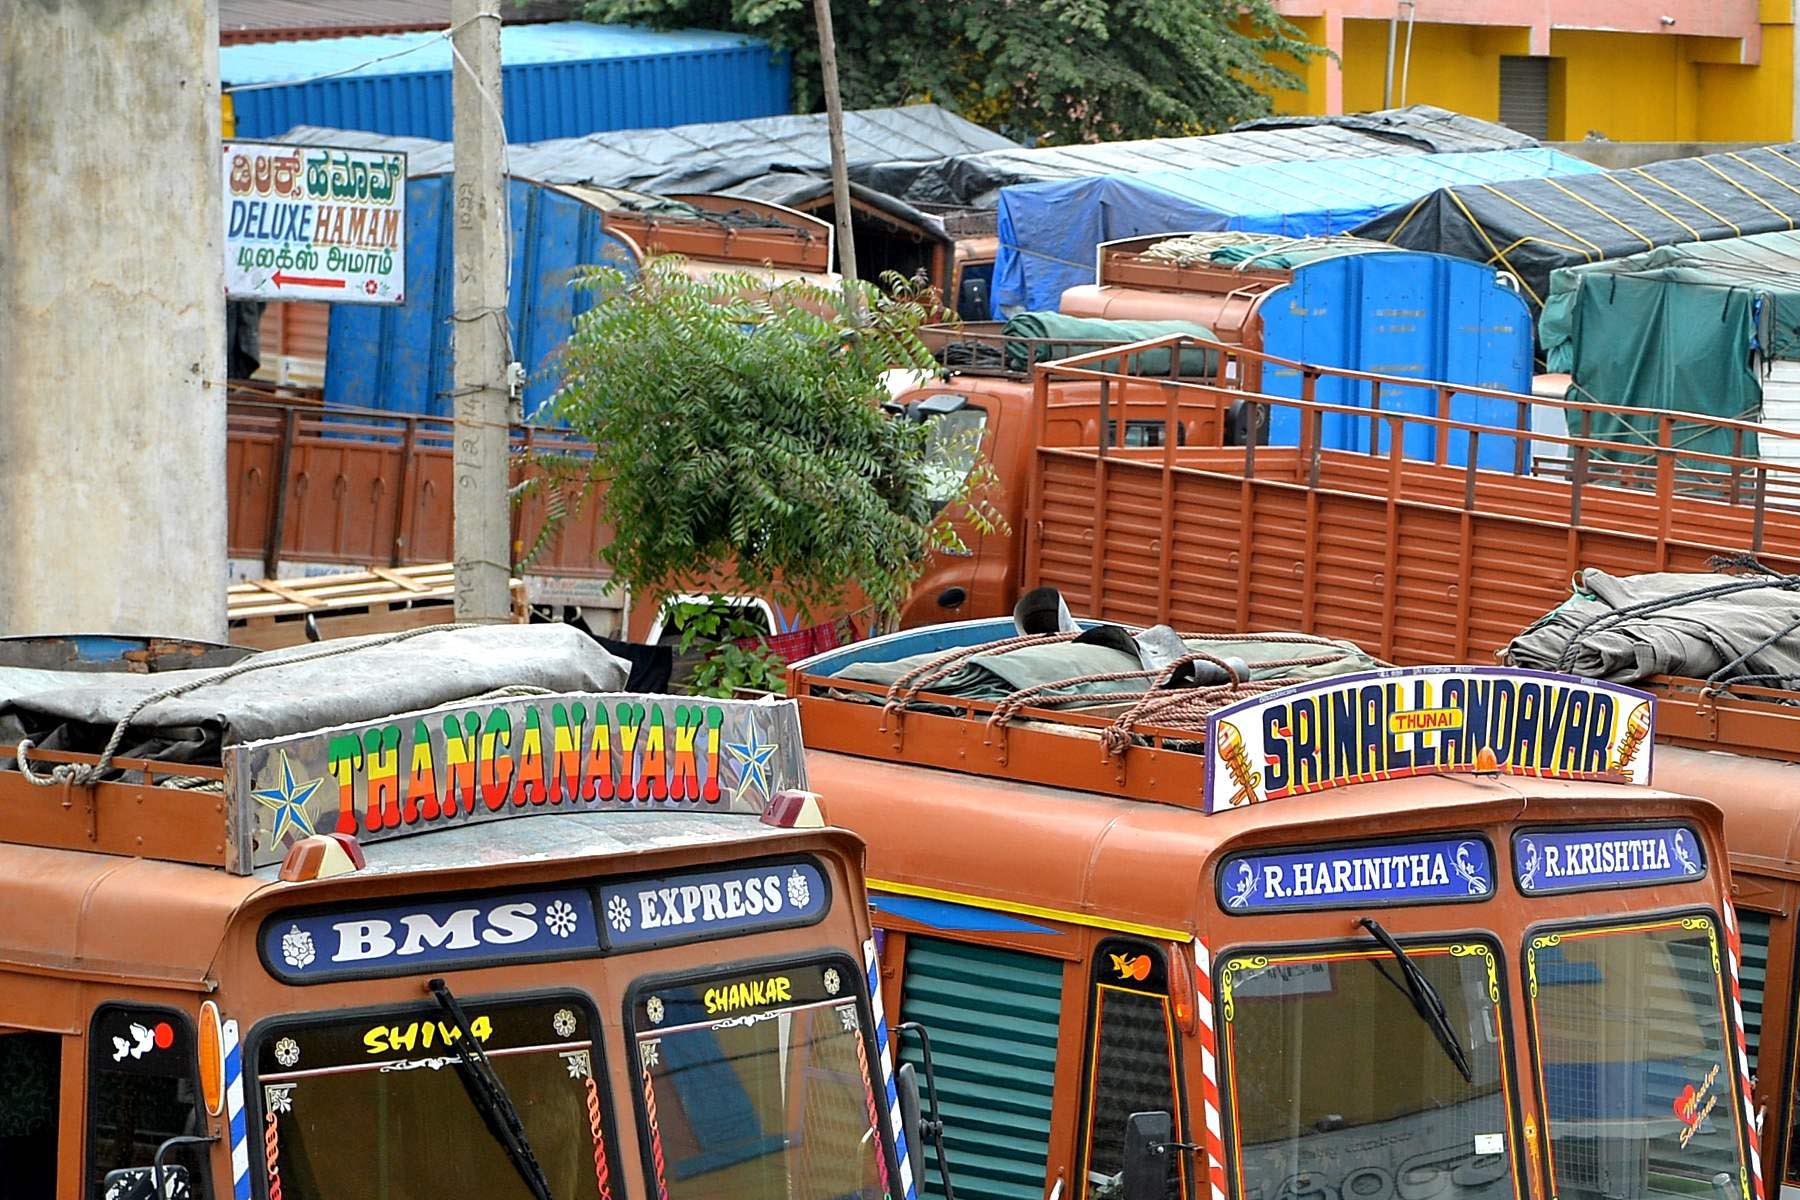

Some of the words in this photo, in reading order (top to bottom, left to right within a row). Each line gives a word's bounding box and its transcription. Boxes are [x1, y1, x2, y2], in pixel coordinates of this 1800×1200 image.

[228, 200, 312, 241] DELUXE
[313, 204, 401, 248] HAMAM
[1394, 711, 1456, 732] THUNAI
[326, 701, 726, 838] THANGANAYAKI
[1263, 854, 1450, 899] R.HARINITHA
[1545, 838, 1671, 879] R.KRISHTHA
[640, 872, 784, 930] EXPRESS
[330, 901, 539, 965] BMS
[703, 975, 792, 1014] SHANKAR
